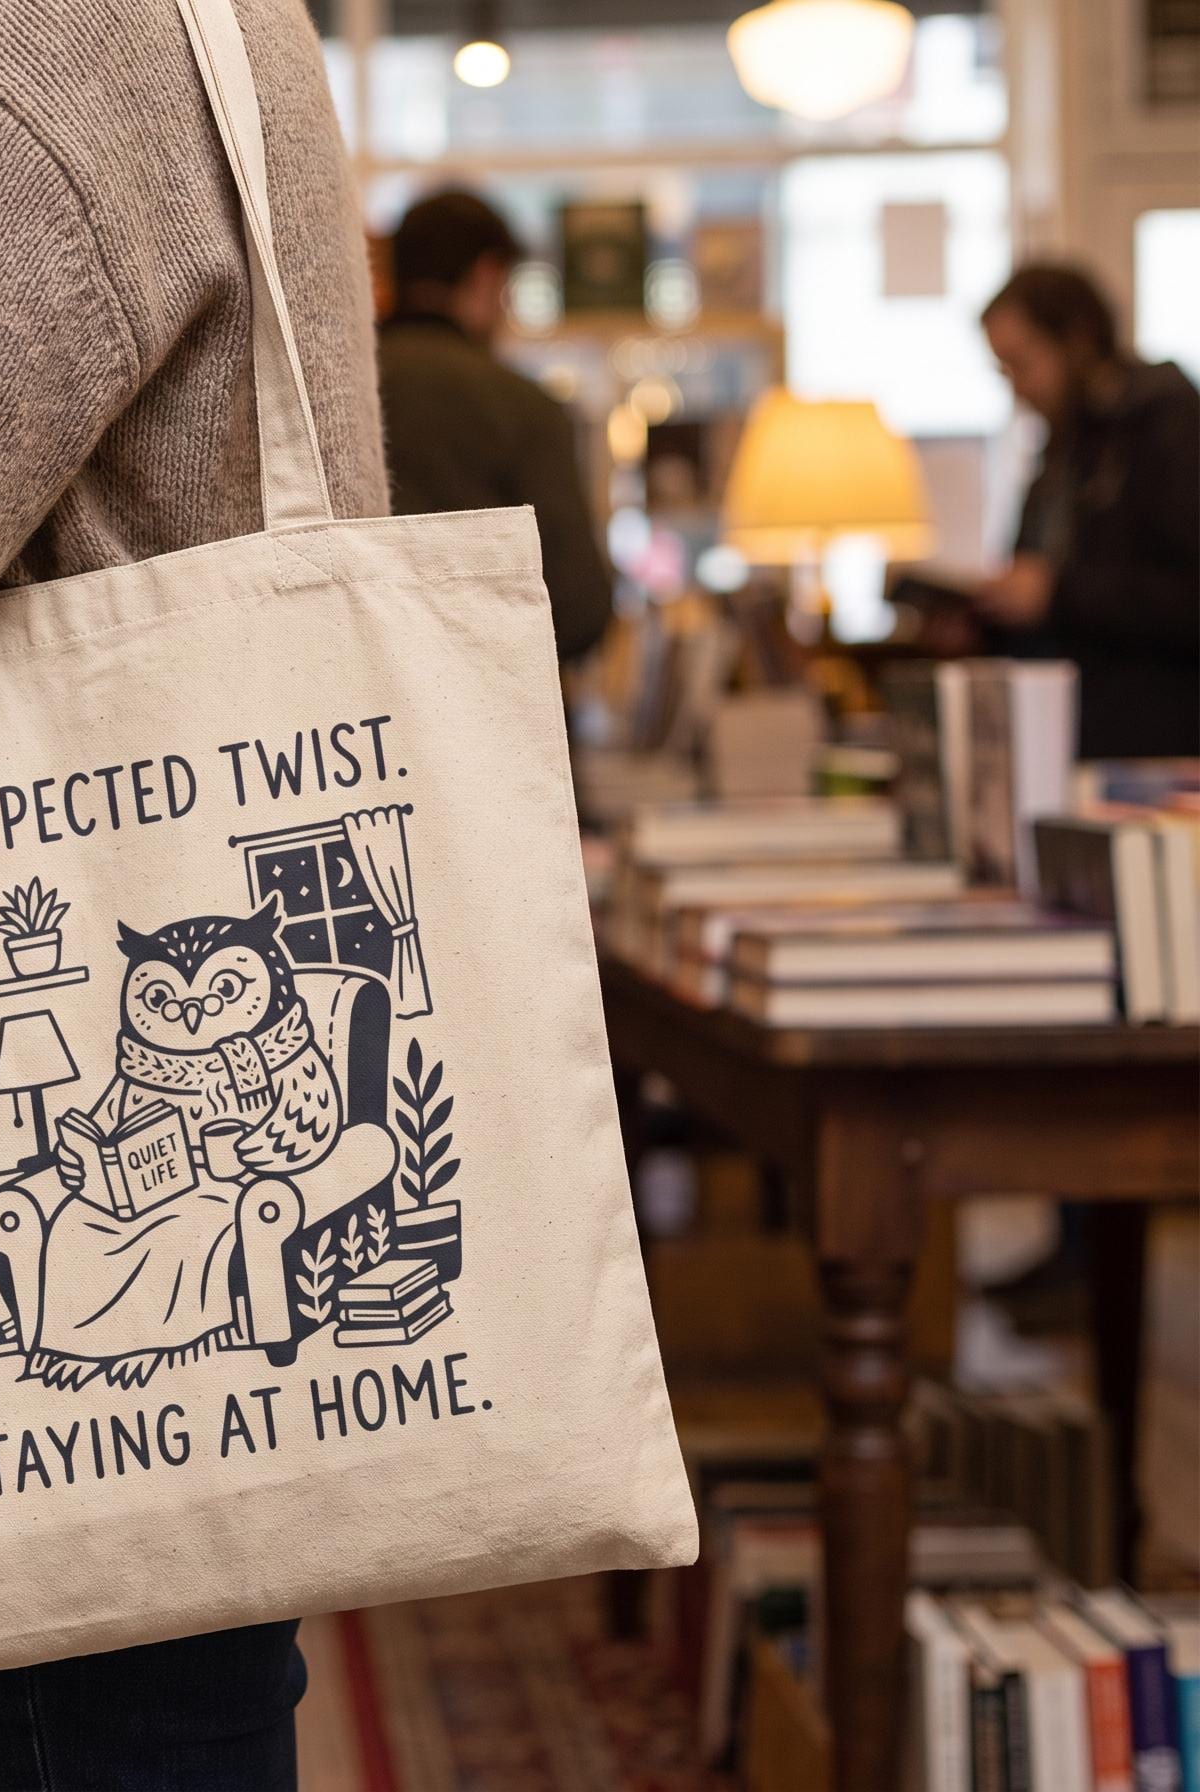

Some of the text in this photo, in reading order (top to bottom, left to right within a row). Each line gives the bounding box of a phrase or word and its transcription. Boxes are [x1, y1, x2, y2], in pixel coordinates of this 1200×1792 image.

[218, 714, 408, 807] TWIST.
[127, 1132, 177, 1171] QUIET
[140, 1158, 178, 1192] LIFE
[220, 1386, 282, 1459] AT
[309, 1352, 493, 1442] HOME.
